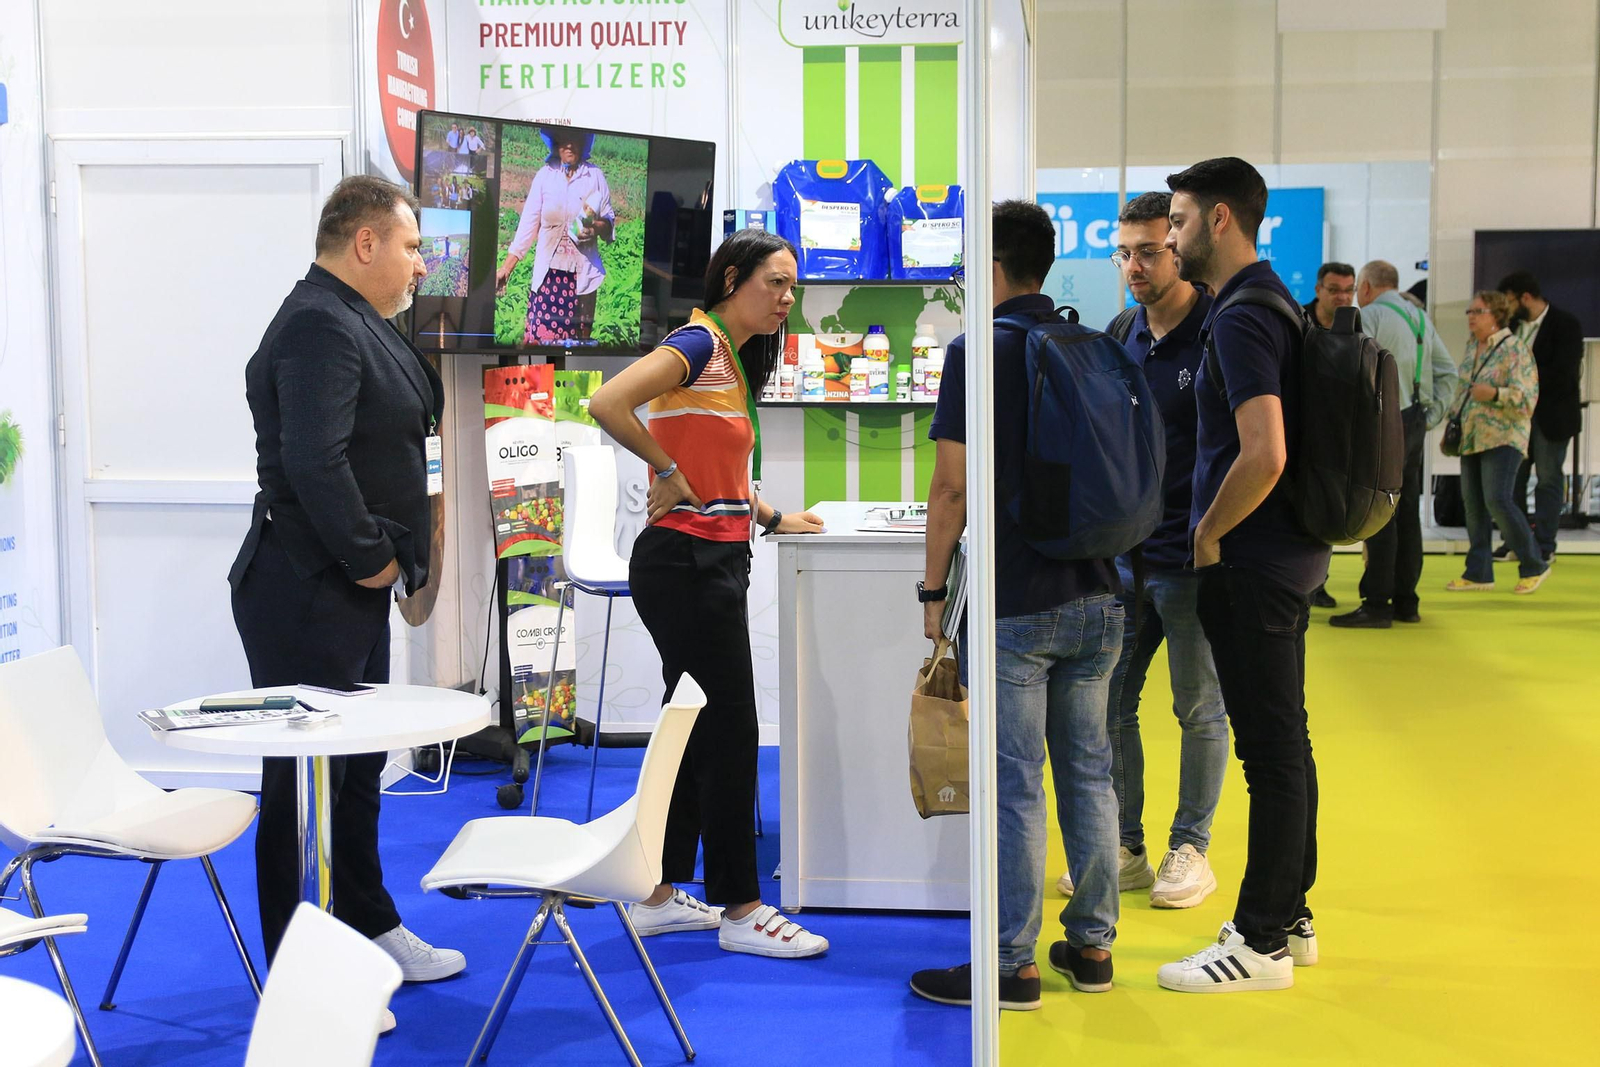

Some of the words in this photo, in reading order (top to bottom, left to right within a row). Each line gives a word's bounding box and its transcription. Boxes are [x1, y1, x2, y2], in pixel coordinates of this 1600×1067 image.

[803, 2, 960, 37] unikeyterra
[479, 22, 582, 48] PREMIUM
[590, 20, 688, 50] QUALITY
[479, 62, 687, 89] FERTILIZERS
[499, 444, 539, 459] OLIGO
[516, 628, 542, 638] COMBI
